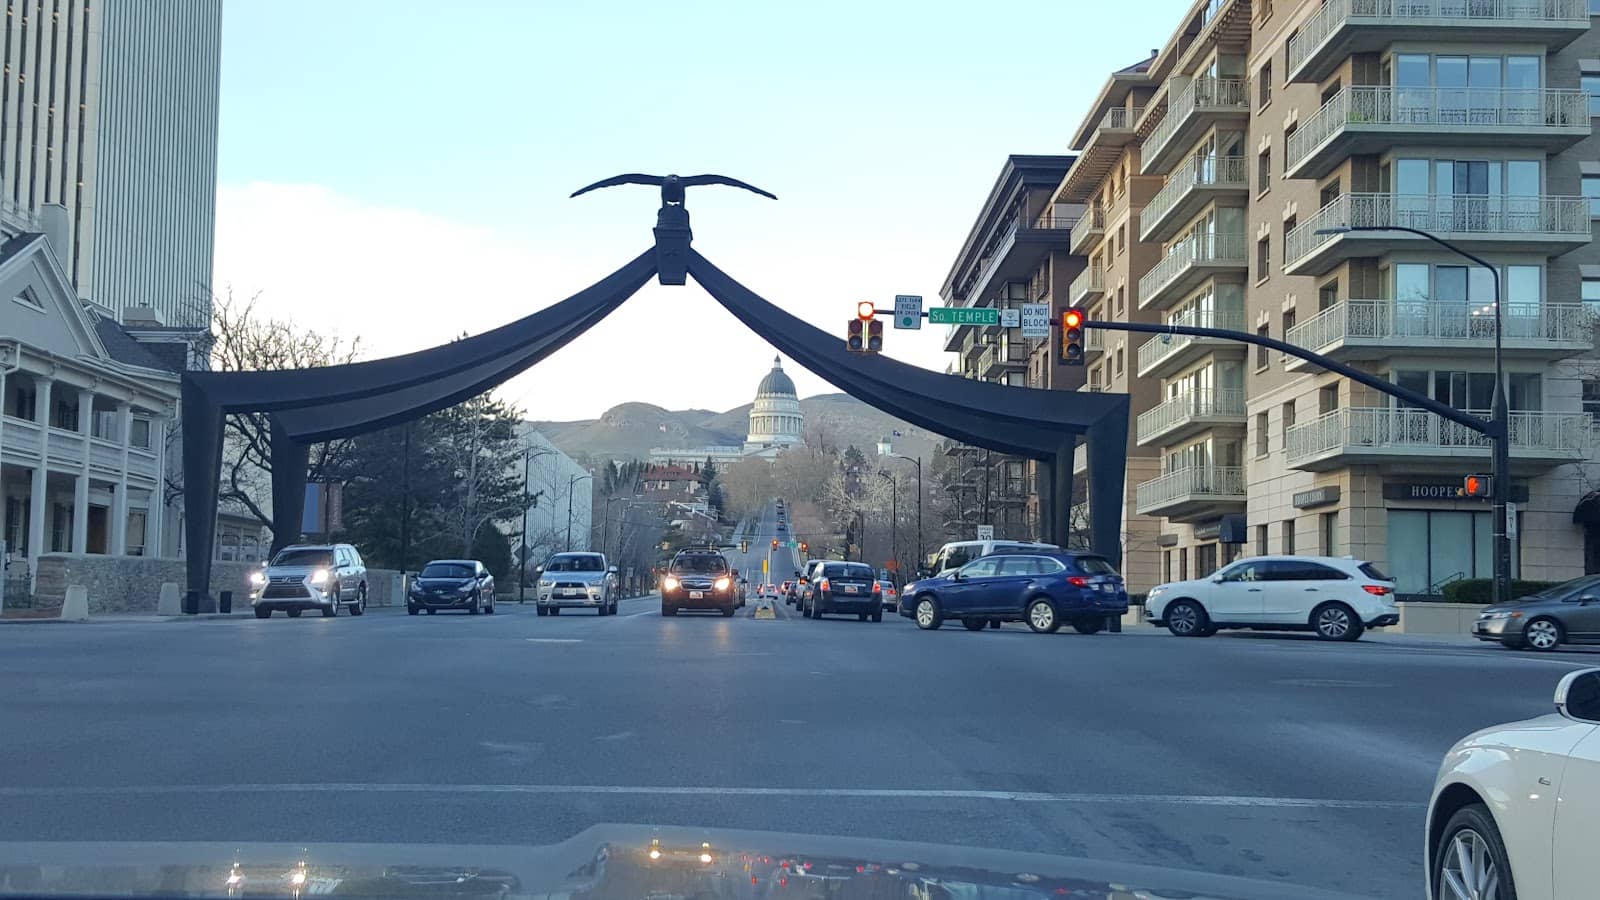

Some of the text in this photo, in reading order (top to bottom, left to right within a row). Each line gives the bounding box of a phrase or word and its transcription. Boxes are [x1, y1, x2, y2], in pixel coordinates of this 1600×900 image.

[1023, 308, 1048, 316] DO NOT
[952, 311, 996, 323] TEMPLE
[1023, 318, 1048, 327] BLOCK
